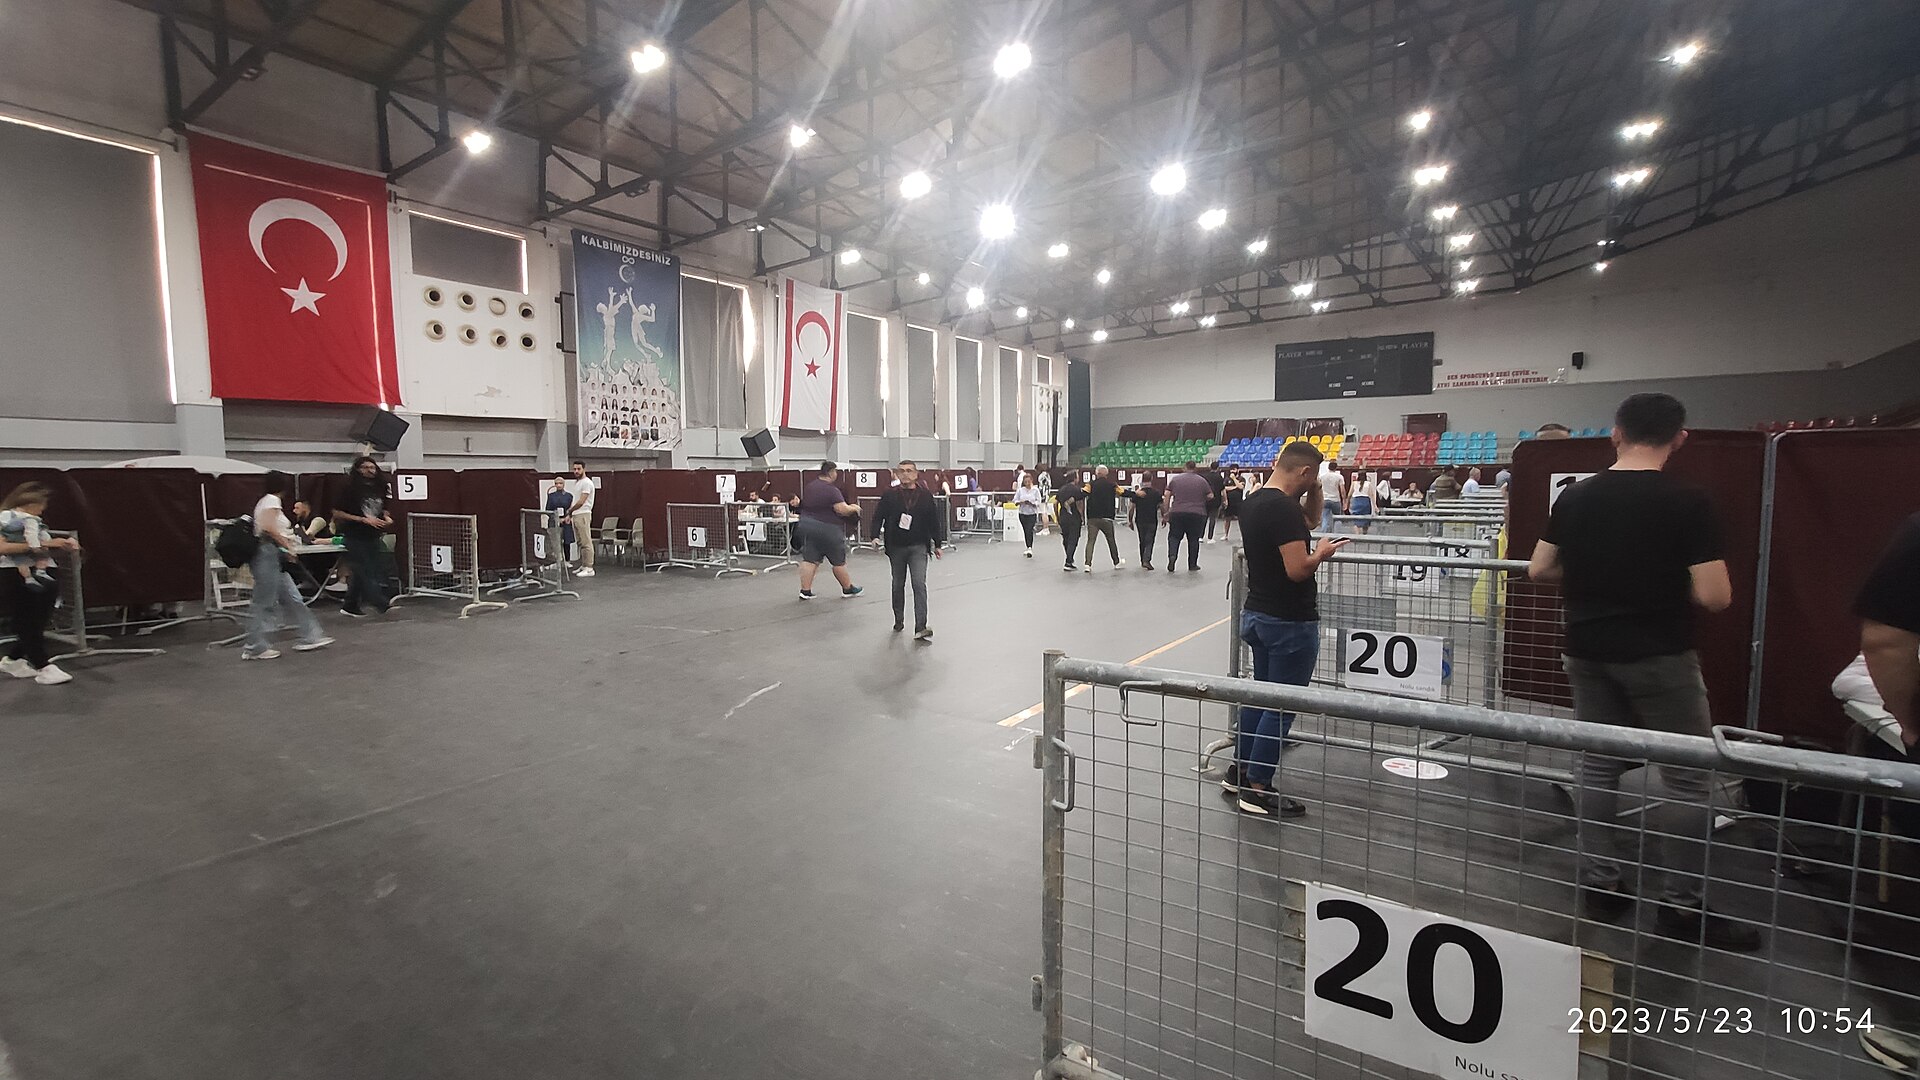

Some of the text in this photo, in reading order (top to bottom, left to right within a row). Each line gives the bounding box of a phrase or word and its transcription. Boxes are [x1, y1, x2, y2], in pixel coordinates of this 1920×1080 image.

[581, 234, 671, 265] KALBİMİZDESİNİZ
[1401, 341, 1429, 350] PLAYER
[404, 476, 414, 492] 5
[720, 476, 727, 488] 7
[860, 473, 867, 483] 8
[957, 476, 963, 485] 9
[960, 508, 966, 517] 8
[691, 528, 698, 541] 6
[750, 524, 755, 536] 7
[536, 536, 541, 550] 6
[436, 548, 442, 565] 5
[1393, 564, 1428, 581] 19
[1349, 632, 1418, 679] 20
[1314, 899, 1504, 1044] 20
[1455, 1055, 1495, 1078] Nolu
